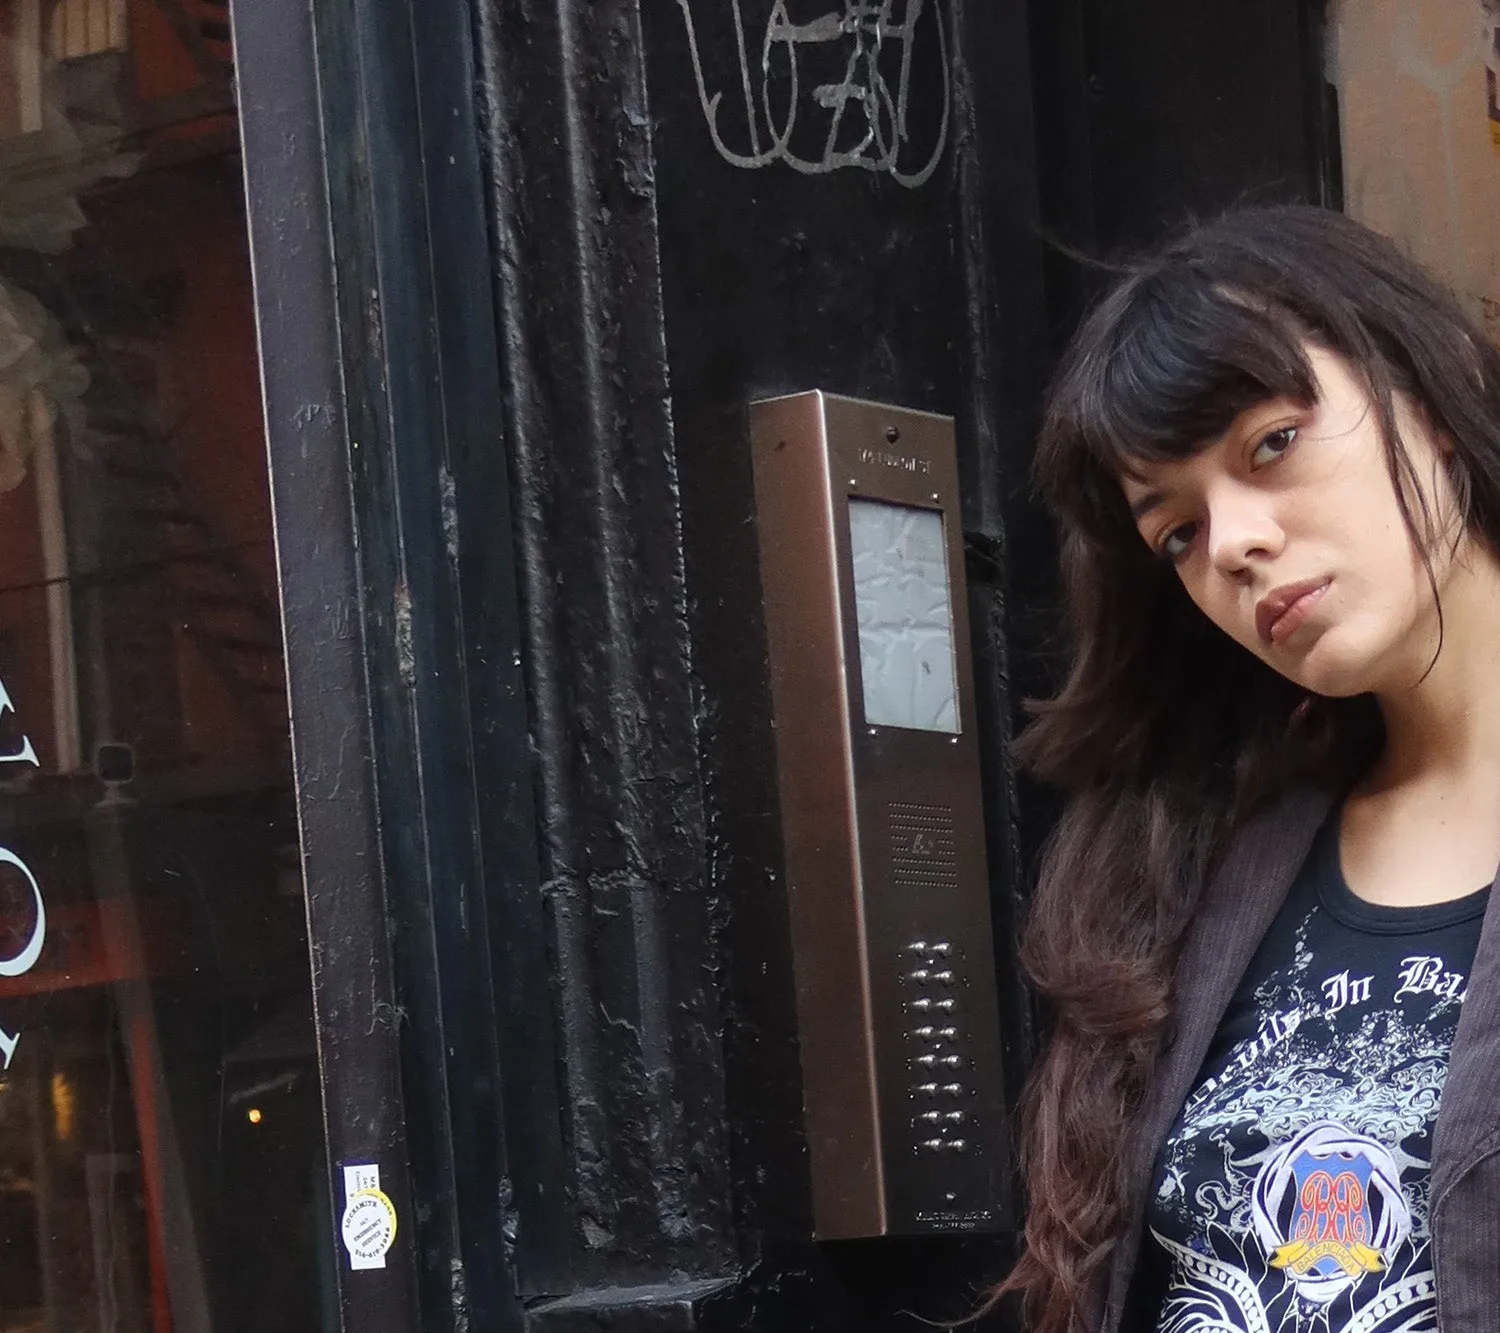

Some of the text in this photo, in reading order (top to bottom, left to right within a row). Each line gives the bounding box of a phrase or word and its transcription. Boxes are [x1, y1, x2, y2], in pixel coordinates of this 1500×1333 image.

[1320, 968, 1376, 1020] In
[345, 1200, 378, 1229] LOCKSMITH
[361, 1230, 382, 1248] SERVICE
[1297, 1242, 1355, 1271] BALENCIAGA
